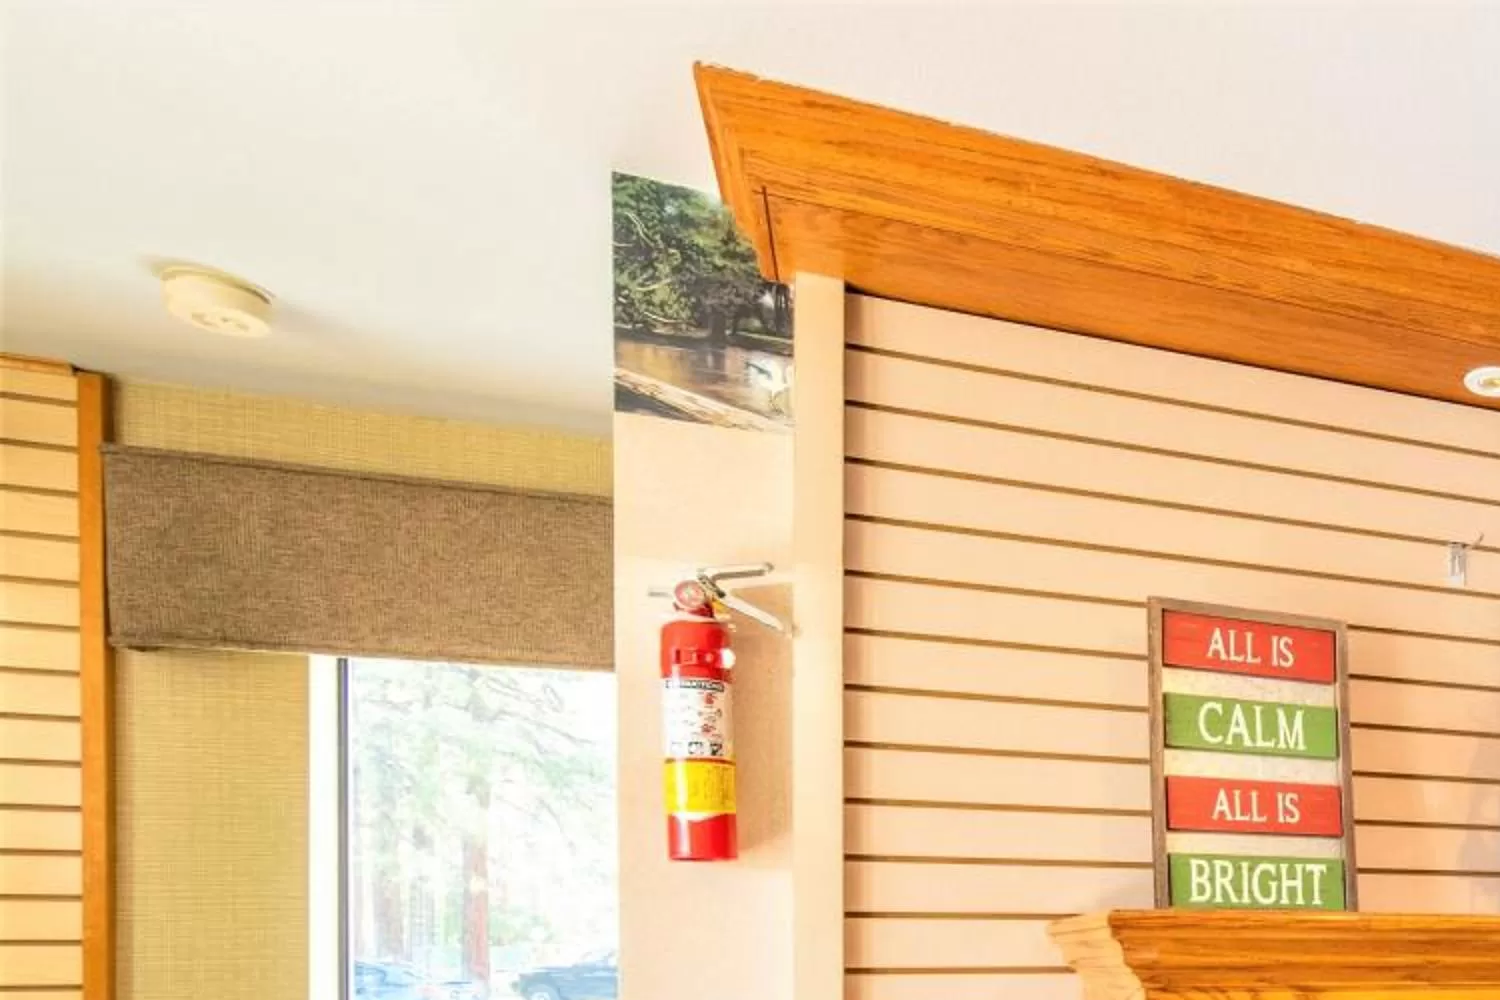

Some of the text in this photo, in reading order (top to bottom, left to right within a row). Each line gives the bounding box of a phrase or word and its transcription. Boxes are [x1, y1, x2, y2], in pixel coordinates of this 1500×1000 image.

[1207, 628, 1295, 668] ALL IS
[1199, 702, 1307, 750] CALM
[1212, 788, 1300, 824] ALL IS
[1189, 859, 1327, 905] BRIGHT
